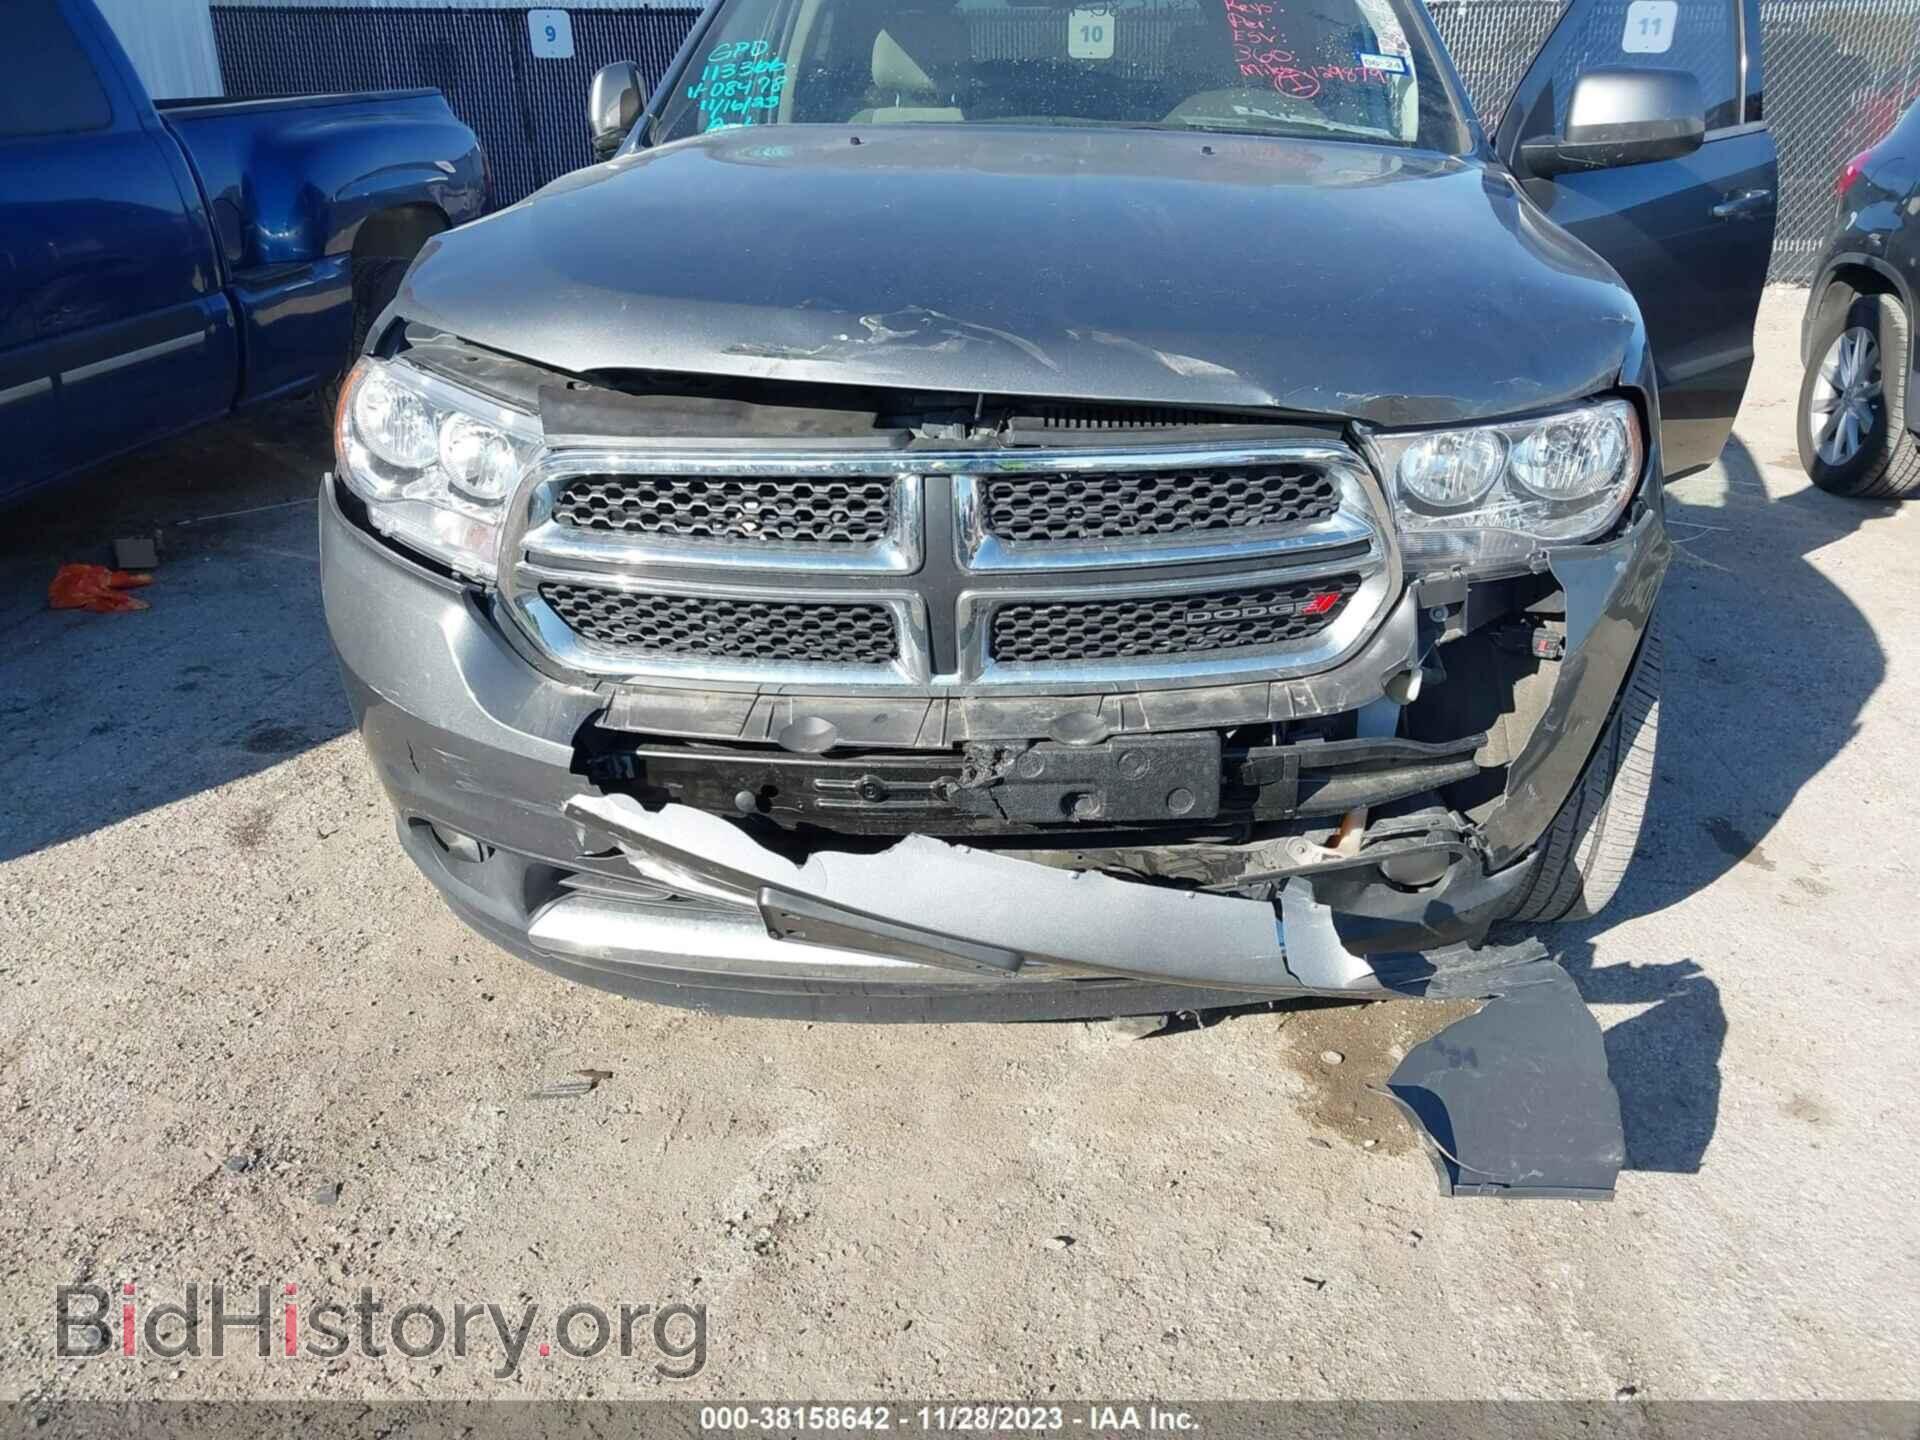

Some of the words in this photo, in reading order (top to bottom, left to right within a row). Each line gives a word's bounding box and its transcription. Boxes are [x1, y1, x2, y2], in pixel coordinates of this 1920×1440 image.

[545, 26, 556, 42] 9
[1080, 26, 1103, 42] 10
[1640, 18, 1662, 36] 11
